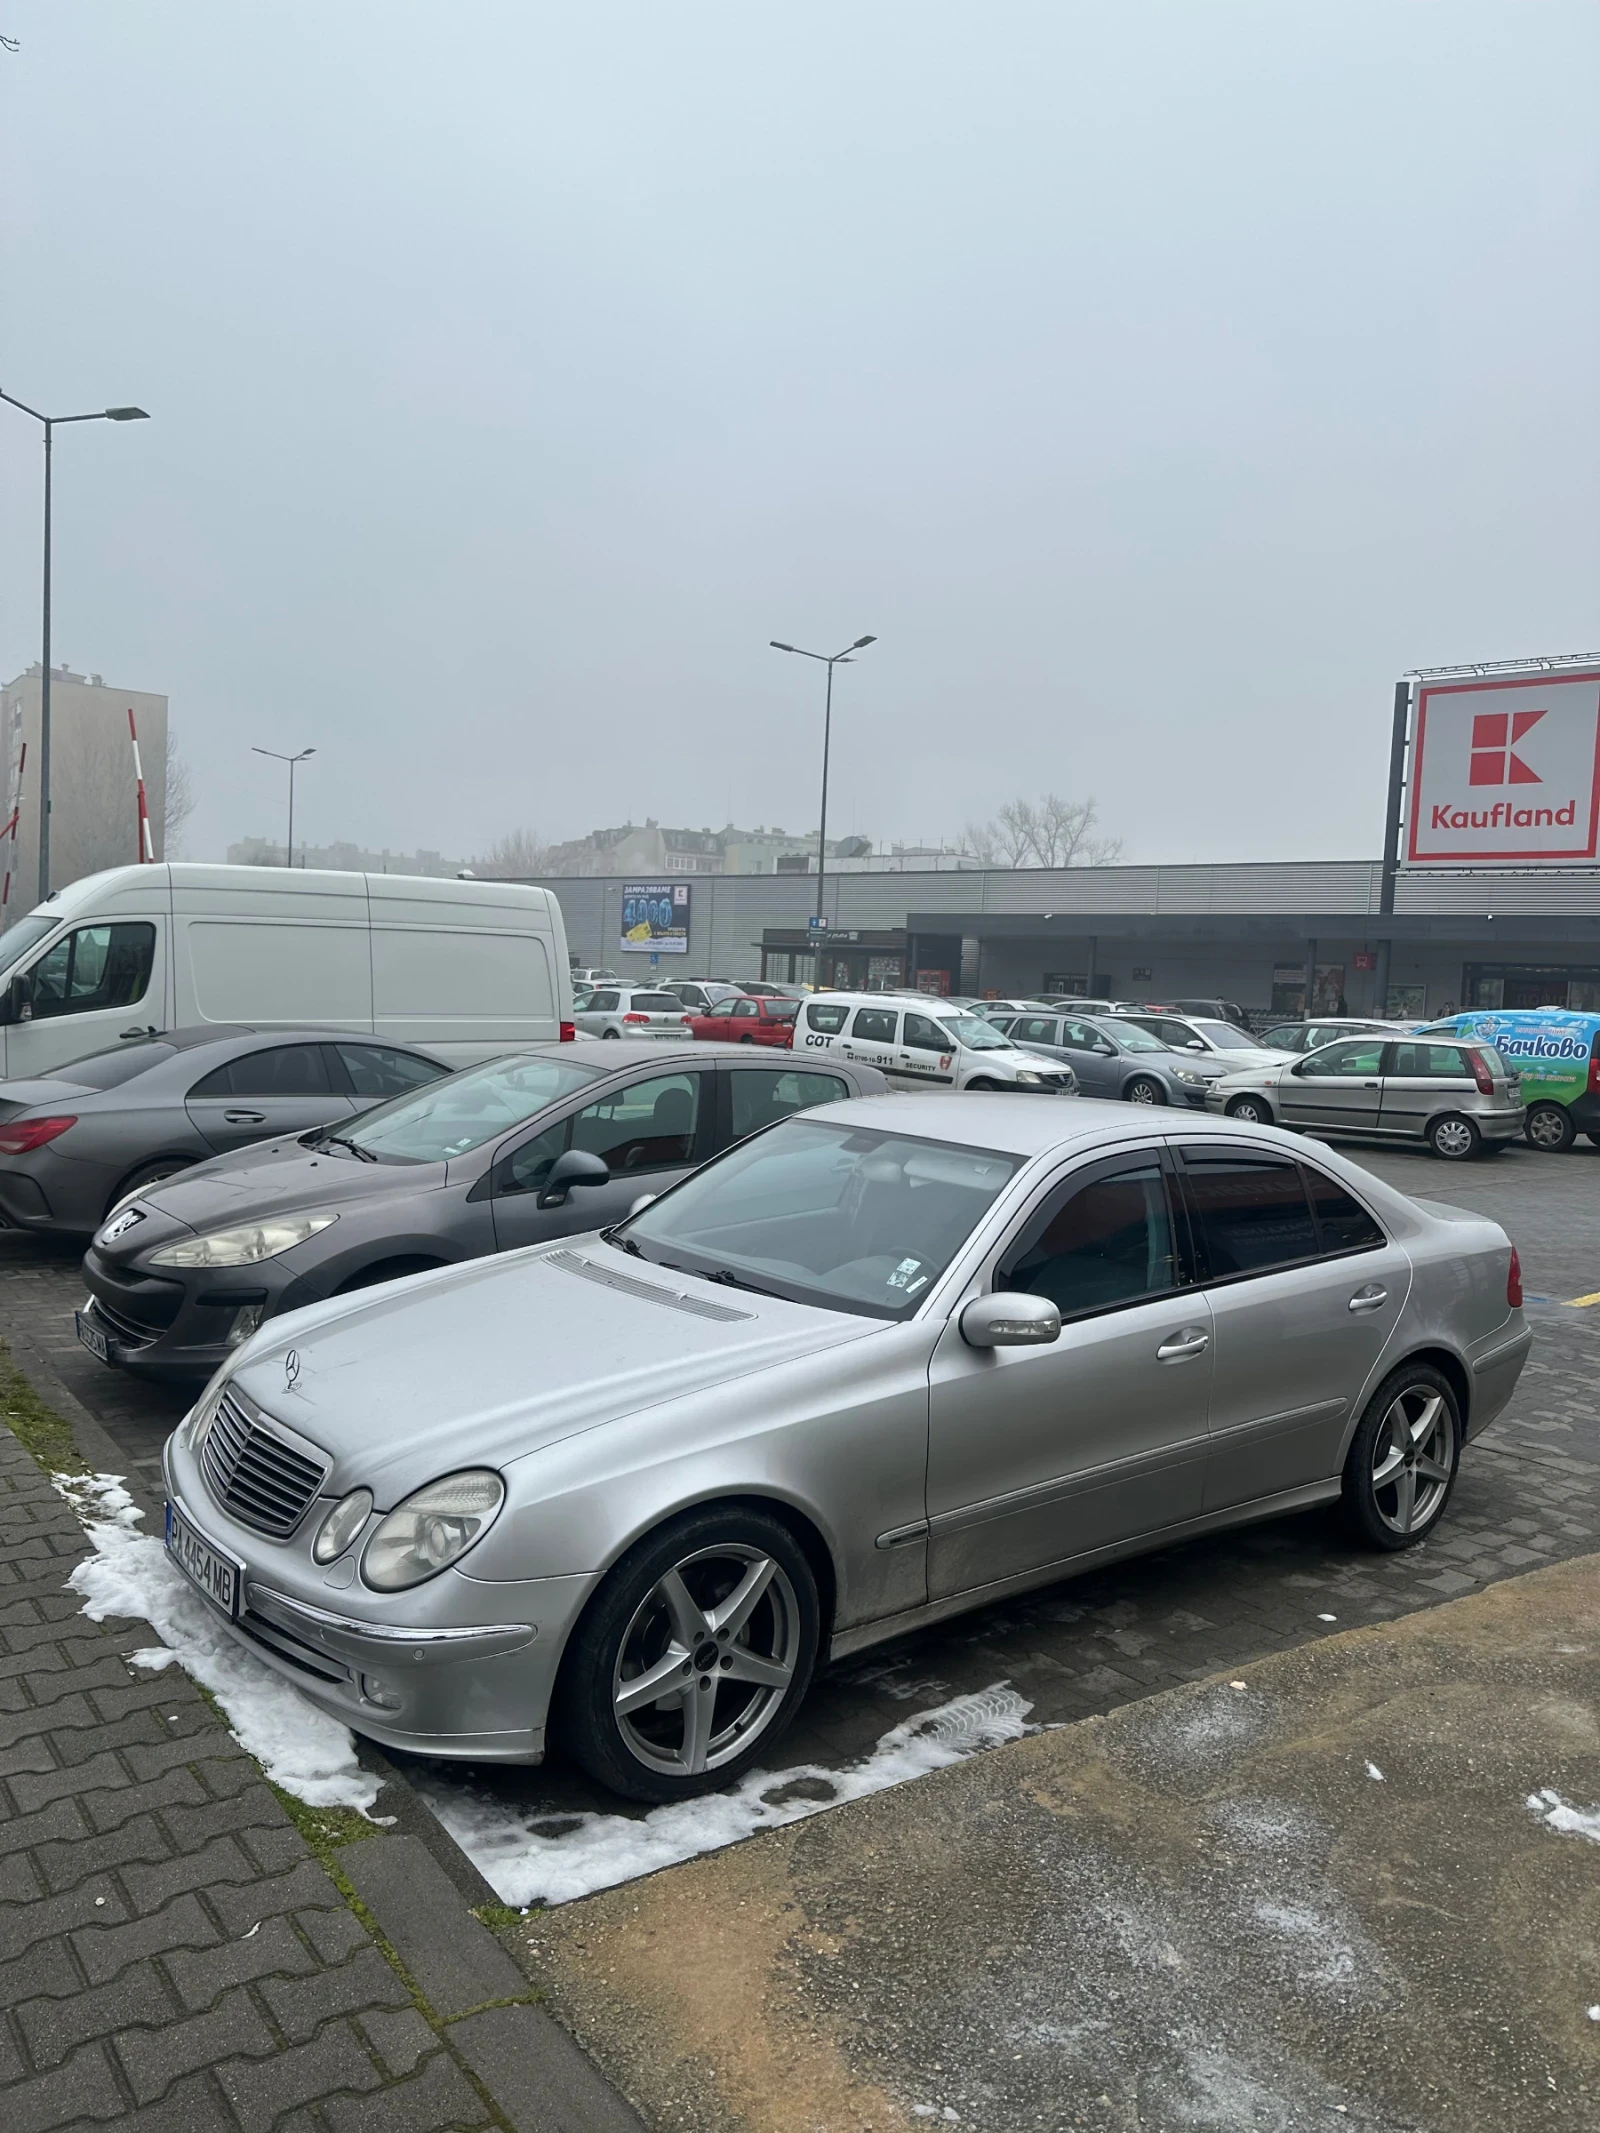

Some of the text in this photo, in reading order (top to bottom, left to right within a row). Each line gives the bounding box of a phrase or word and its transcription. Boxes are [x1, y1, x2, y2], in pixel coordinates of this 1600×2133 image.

[1431, 799, 1576, 829] Kaufland
[624, 898, 672, 927] 4000
[1495, 1035, 1588, 1058] Бачково
[905, 1062, 936, 1071] SECURITY
